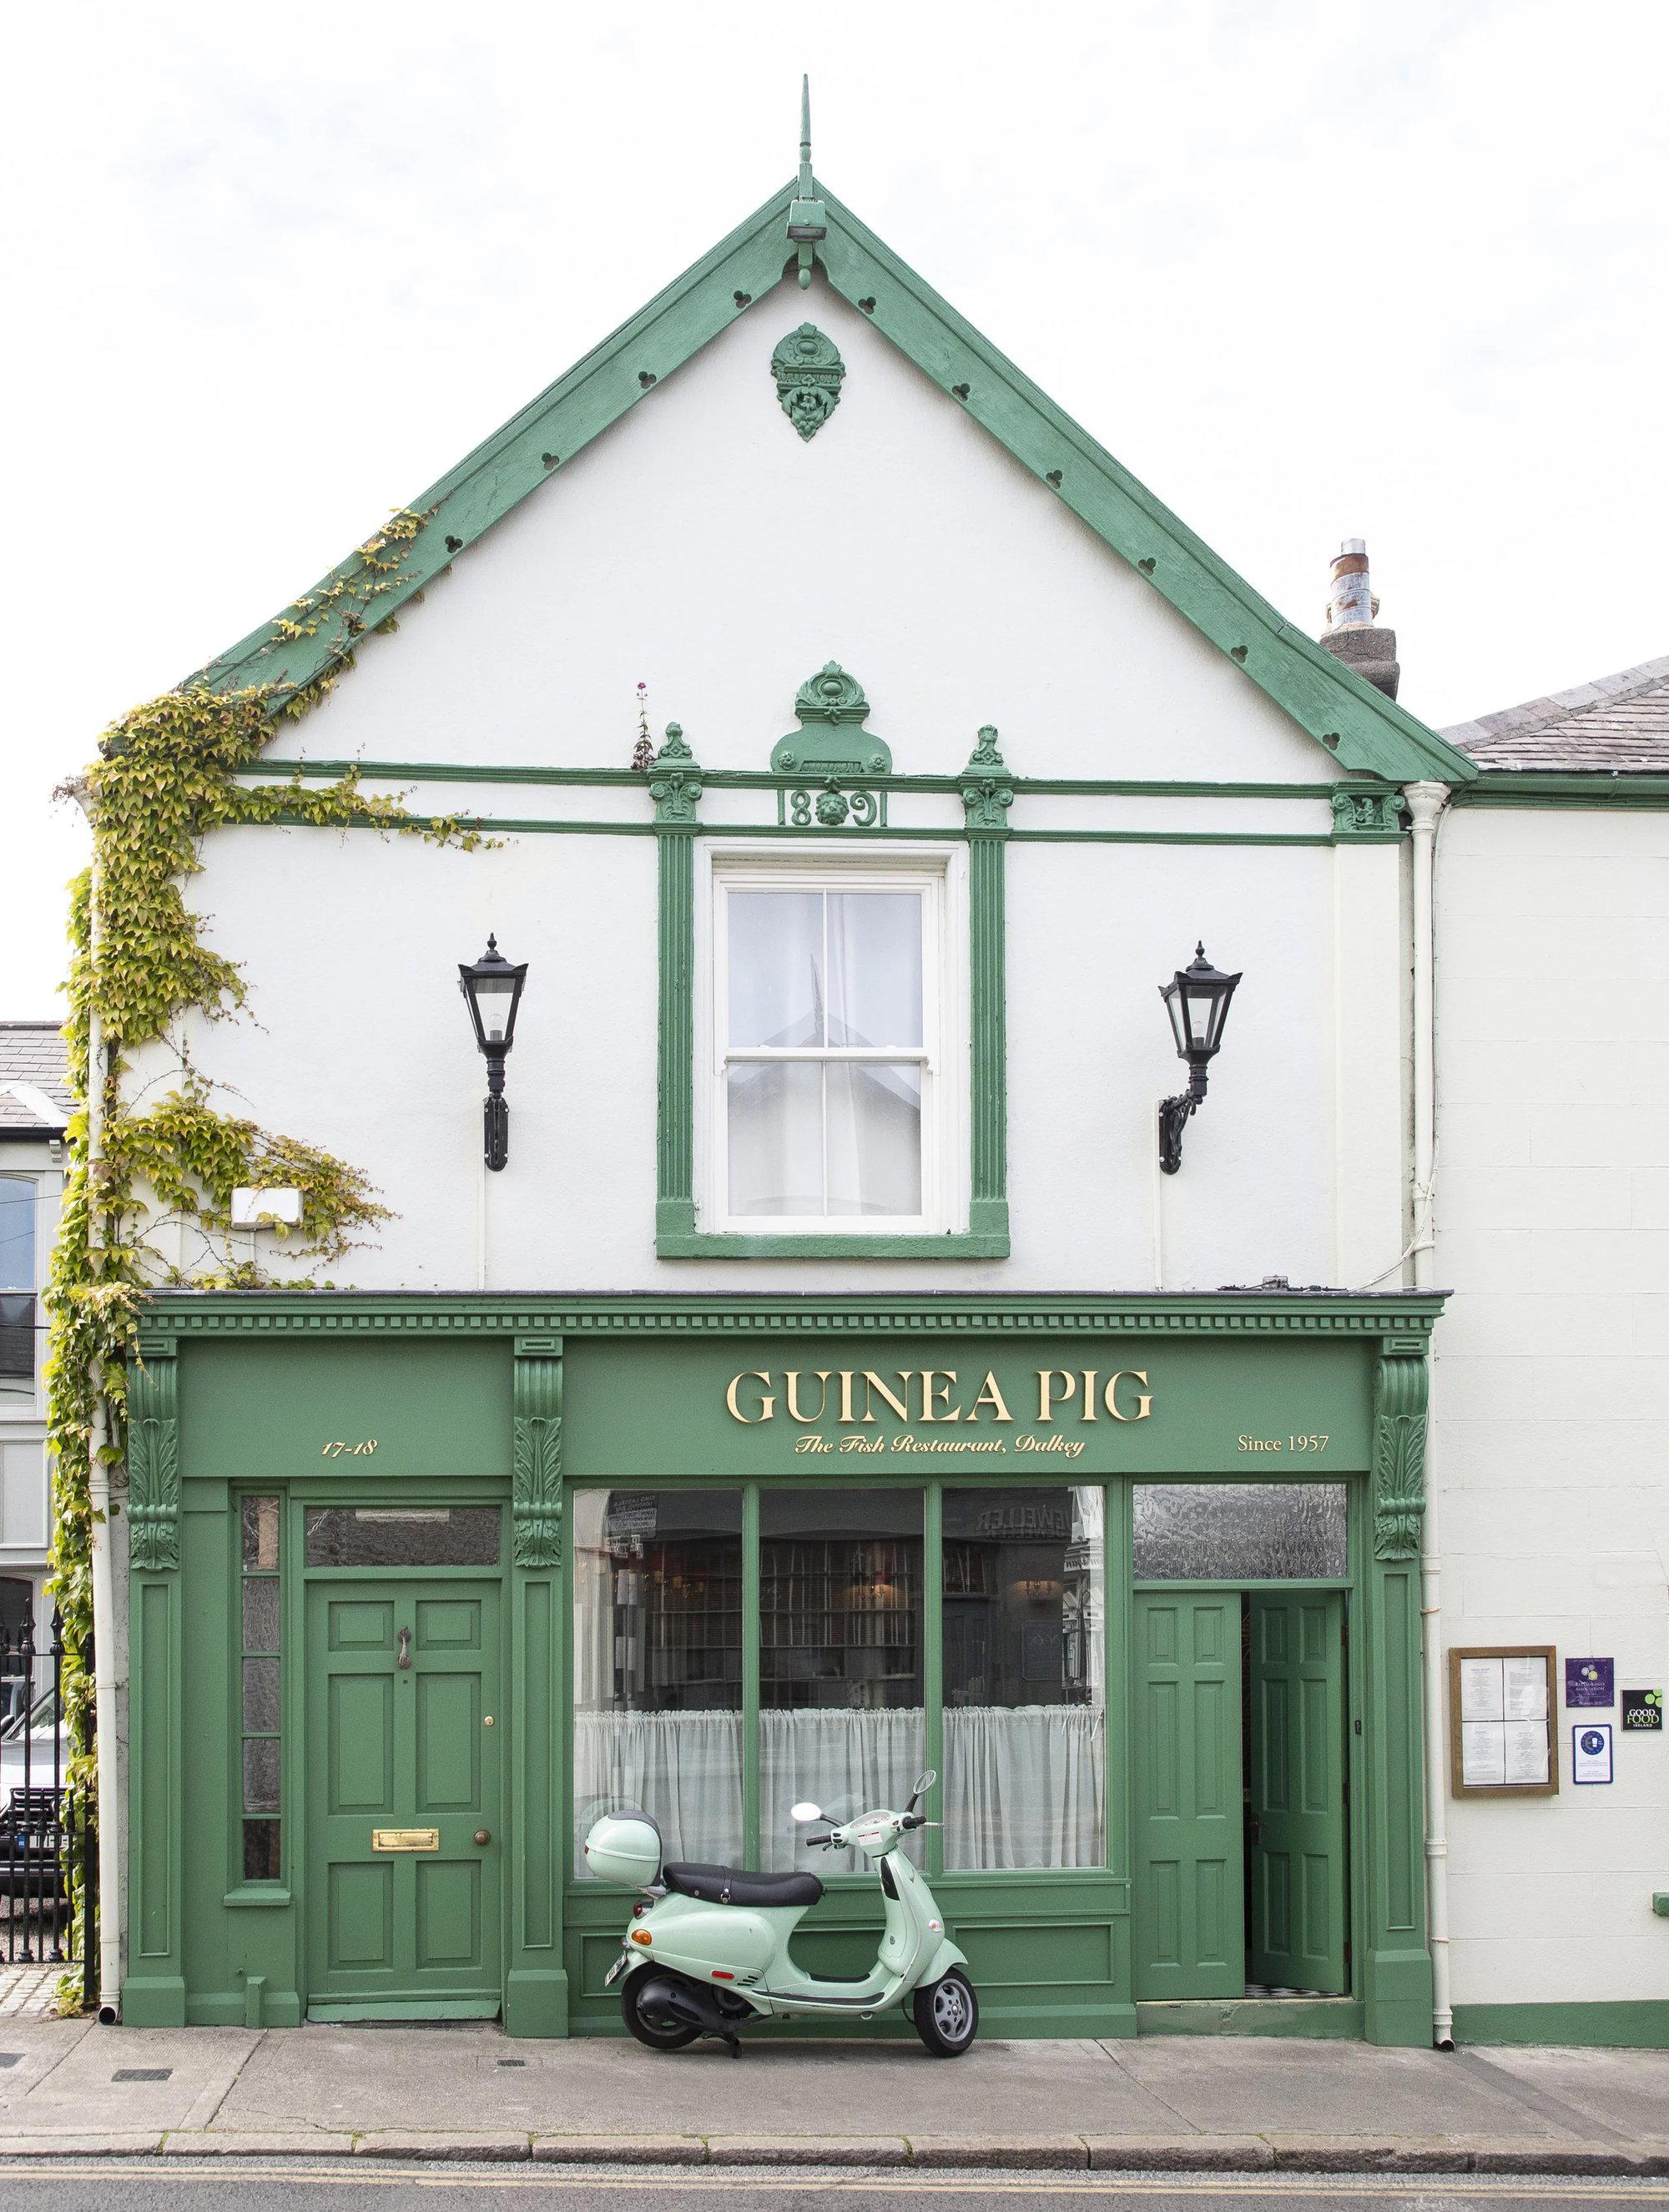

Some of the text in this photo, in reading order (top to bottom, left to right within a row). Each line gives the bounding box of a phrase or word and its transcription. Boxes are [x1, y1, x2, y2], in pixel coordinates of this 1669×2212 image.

[726, 1370, 1154, 1423] GUINEA PIG
[321, 1439, 379, 1458] 17-18
[794, 1434, 1087, 1459] The Fish Restaurant, Dalkey
[1238, 1434, 1329, 1452] Since 1957
[1626, 1715, 1659, 1724] FOOD
